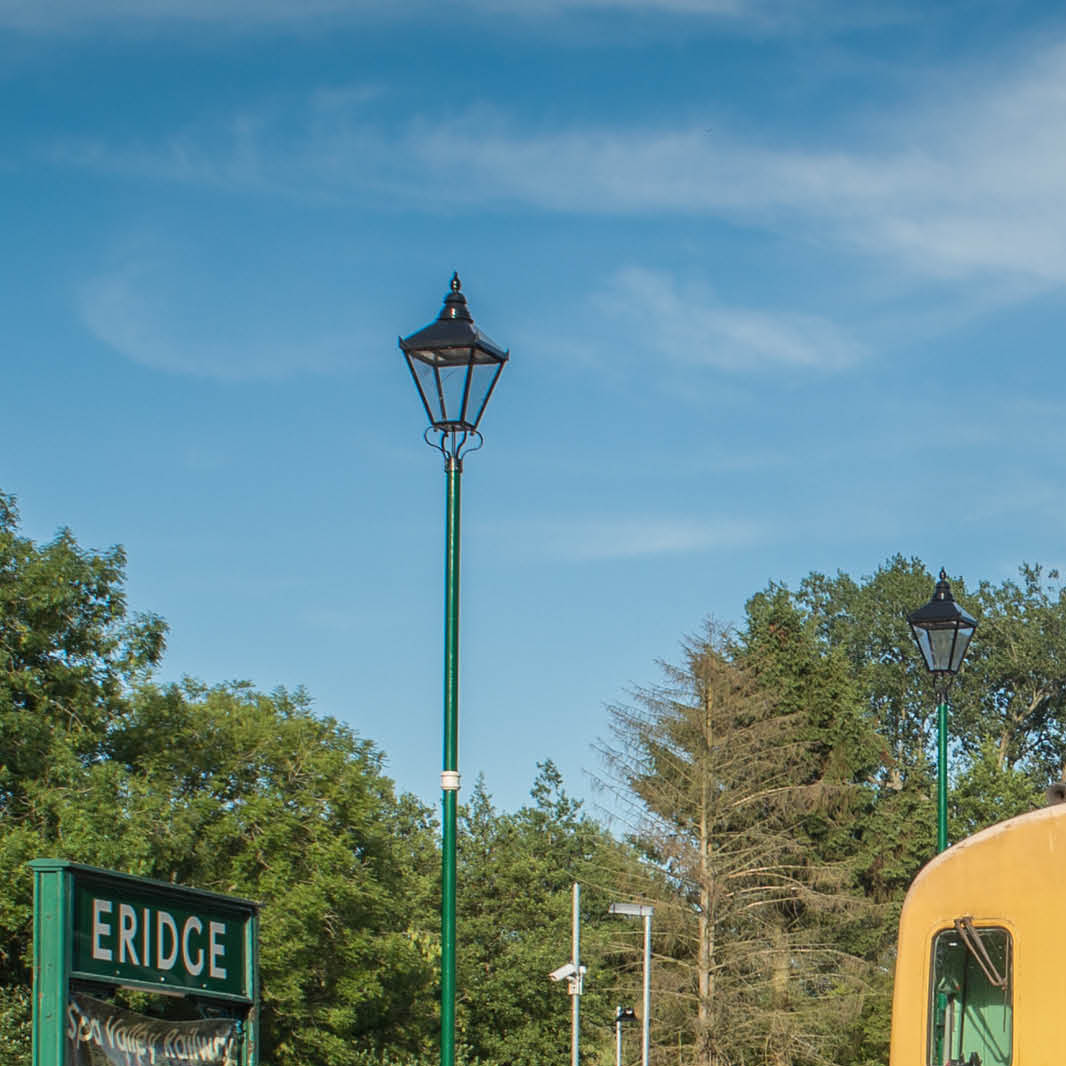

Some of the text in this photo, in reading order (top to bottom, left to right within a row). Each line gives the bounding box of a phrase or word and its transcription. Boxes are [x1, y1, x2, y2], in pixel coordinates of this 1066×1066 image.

[92, 898, 227, 980] ERIDGE
[67, 1001, 103, 1049] Spa
[105, 1016, 160, 1064] Valley
